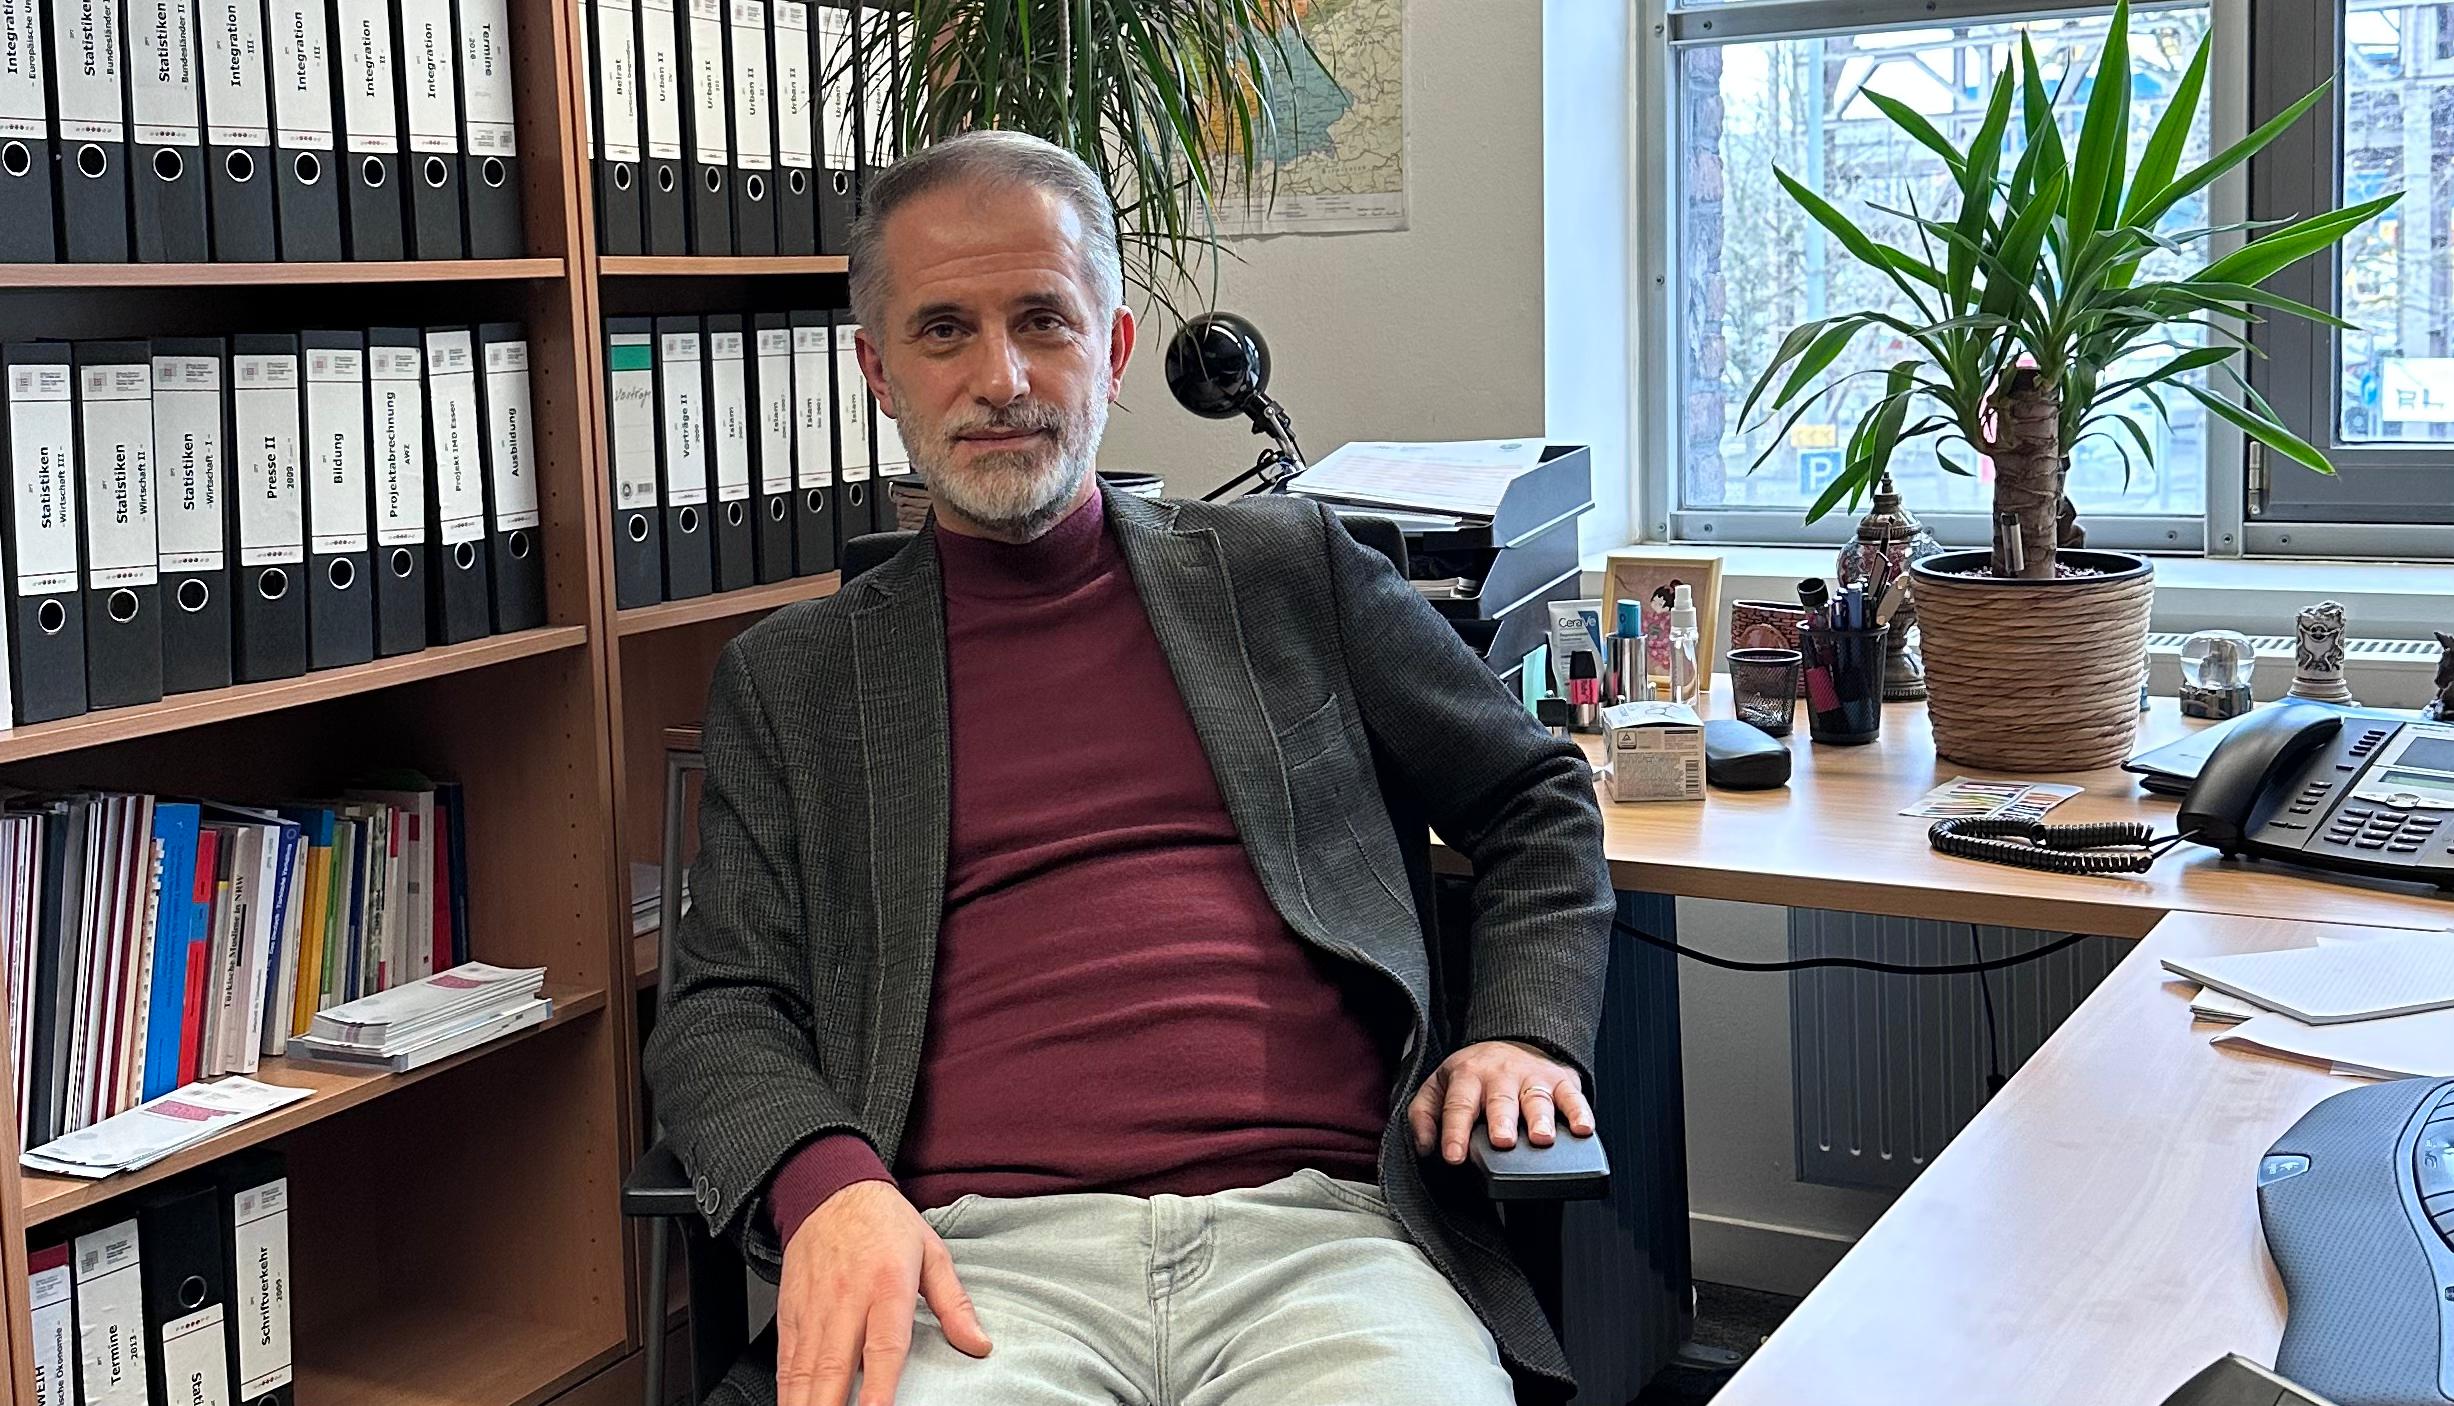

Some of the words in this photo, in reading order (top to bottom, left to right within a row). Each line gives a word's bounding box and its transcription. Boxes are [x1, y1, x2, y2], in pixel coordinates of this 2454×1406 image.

[104, 5, 114, 75] Bundesländer
[157, 2, 170, 82] Statistiken
[178, 16, 190, 83] Bundesländer
[227, 5, 242, 87] Integration
[247, 40, 255, 54] III
[294, 12, 308, 91] Integration
[361, 20, 376, 97] Integration
[380, 55, 386, 64] II
[425, 23, 437, 98] Integration
[482, 23, 492, 76] Termine
[658, 52, 664, 62] II
[706, 60, 711, 70] II
[706, 75, 714, 109] Urban
[748, 68, 754, 78] II
[790, 68, 796, 78] II
[790, 82, 798, 115] Urban
[681, 394, 688, 404] II
[138, 451, 146, 461] II
[265, 436, 276, 450] II
[387, 392, 400, 518] Projektabrechnung
[510, 407, 520, 477] Ausbildung
[681, 407, 690, 458] Vorträge
[182, 433, 195, 510] Statistiken
[205, 455, 215, 505] Wirtschaft
[267, 453, 278, 499] Presse
[333, 433, 344, 484] Bildung
[454, 456, 462, 492] Projekt
[1810, 456, 1833, 490] P
[39, 446, 52, 529] Statistiken
[60, 470, 68, 522] Wirtschaft
[114, 444, 128, 524] Statistiken
[139, 463, 148, 515] Wirtschaft
[1559, 616, 1597, 627] CeraVe
[234, 904, 242, 914] in
[235, 874, 244, 902] NRW
[228, 917, 241, 958] Muslime
[224, 961, 238, 1008] Türkische
[260, 1247, 271, 1346] Schriftverkehr
[56, 1326, 64, 1379] Ökonomie
[111, 1324, 122, 1386] Termine
